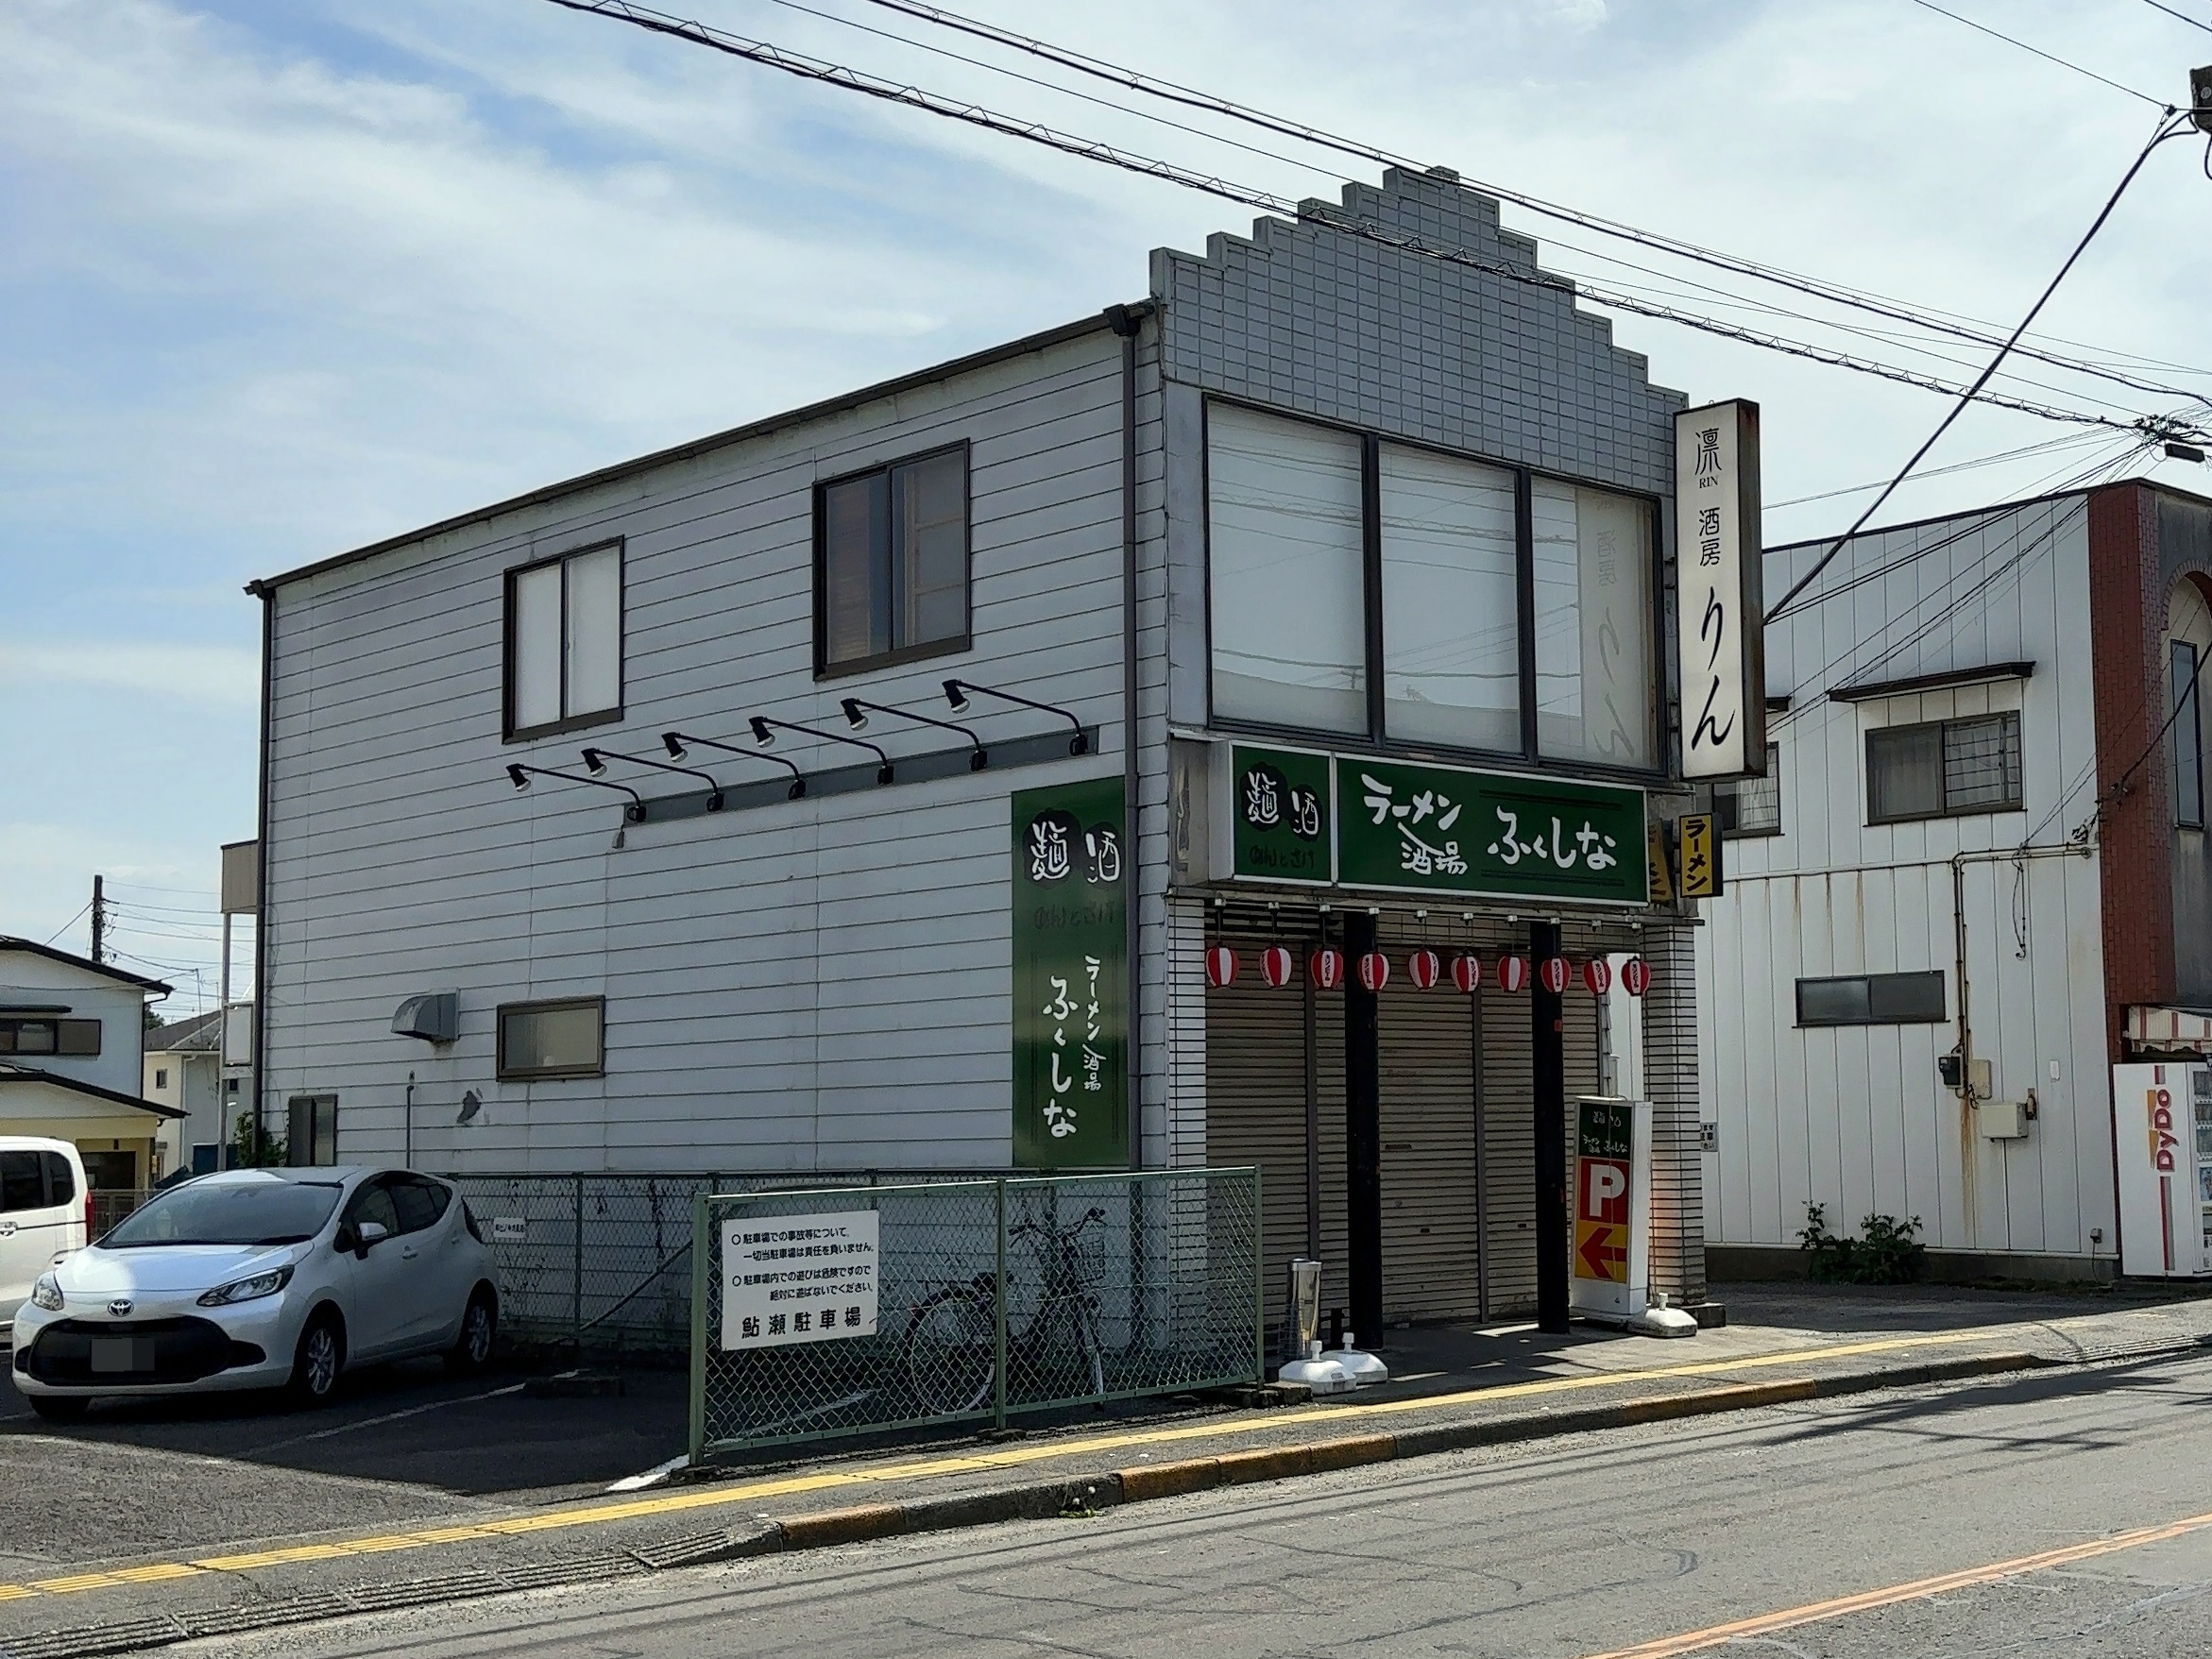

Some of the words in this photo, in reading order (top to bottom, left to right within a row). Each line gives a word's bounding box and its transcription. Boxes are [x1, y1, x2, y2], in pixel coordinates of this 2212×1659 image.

[1699, 475, 1719, 489] RIN
[1699, 507, 1721, 567] 酒房
[1692, 585, 1735, 751] りん
[1361, 773, 1463, 831] ラーメン
[1399, 829, 1469, 874] 酒場
[1488, 805, 1617, 871] ふくしな
[1686, 819, 1708, 891] ラーメン
[1043, 975, 1079, 1138] ふくしな
[2154, 1089, 2179, 1172] DyDo
[1589, 1164, 1625, 1217] P
